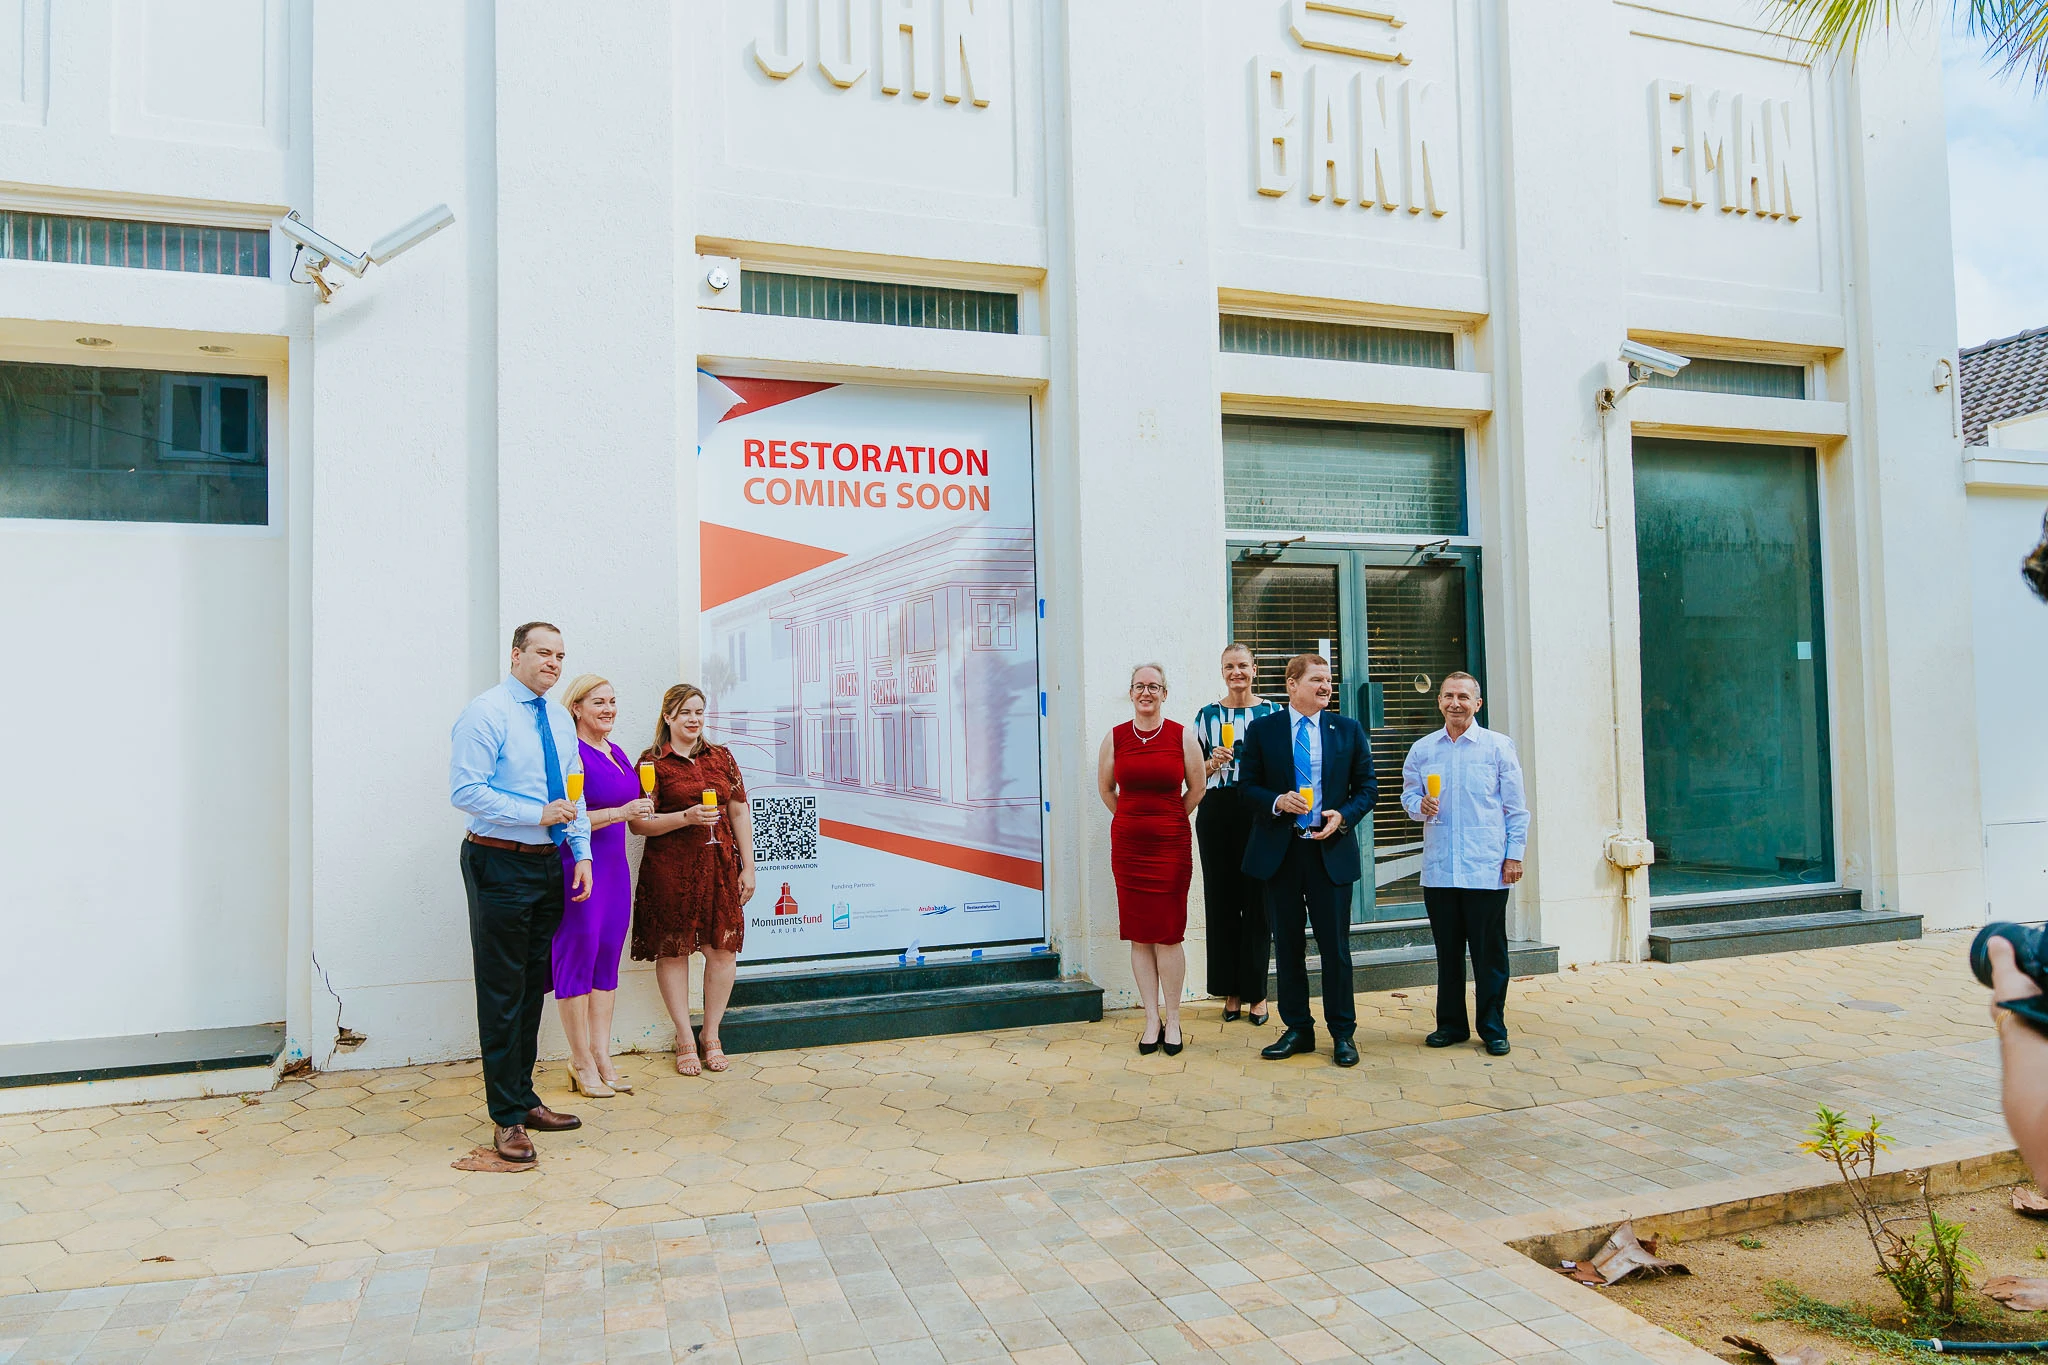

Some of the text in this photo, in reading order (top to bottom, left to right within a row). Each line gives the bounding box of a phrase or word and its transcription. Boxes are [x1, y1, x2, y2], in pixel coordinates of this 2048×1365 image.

[1251, 55, 1448, 218] BANK
[1649, 78, 1803, 223] EMAN
[744, 439, 989, 476] RESTORATION
[744, 478, 990, 511] COMING SOON
[836, 672, 860, 697] JOHN
[871, 678, 898, 705] BANK
